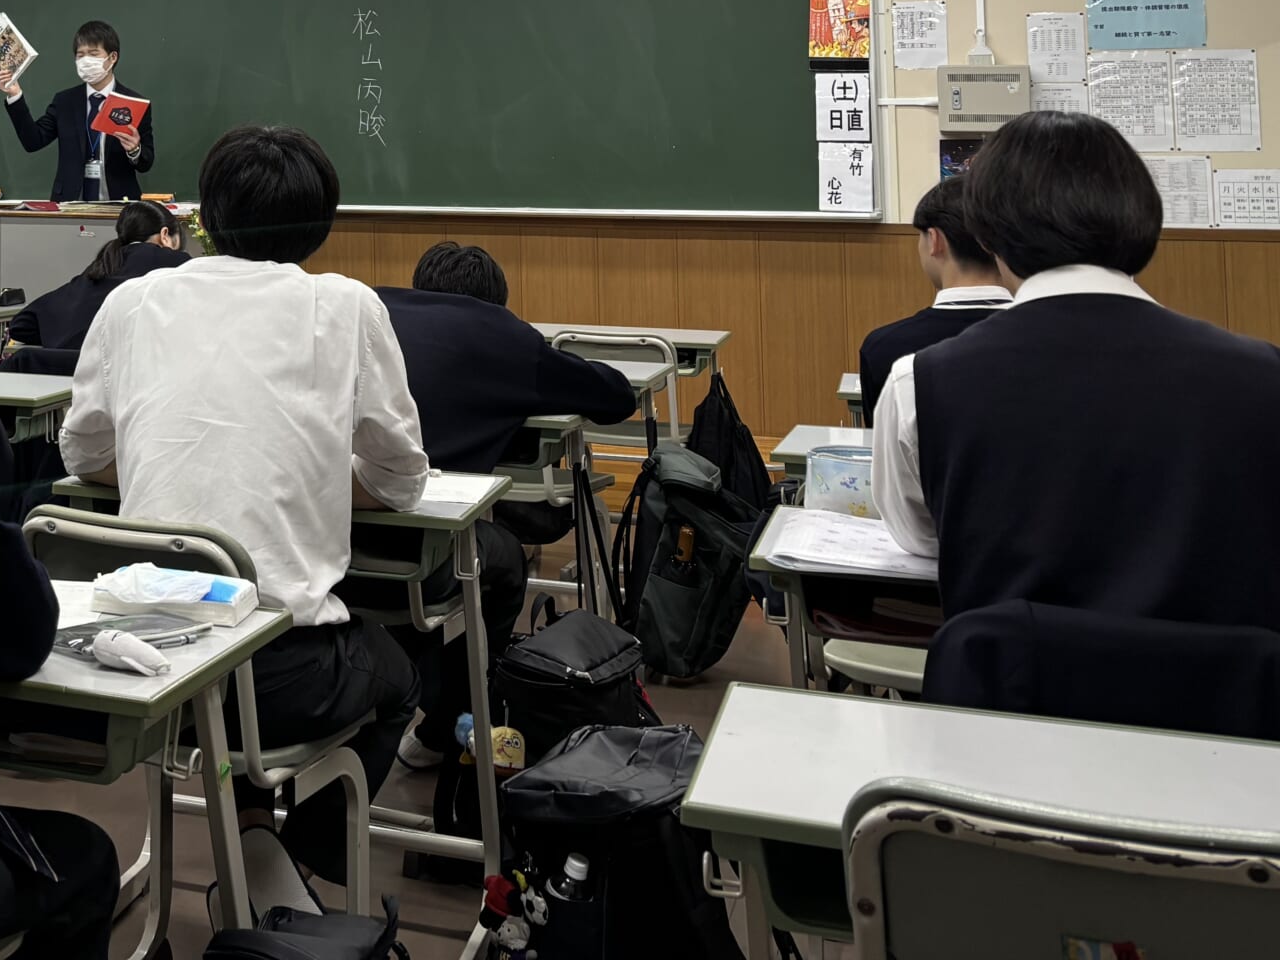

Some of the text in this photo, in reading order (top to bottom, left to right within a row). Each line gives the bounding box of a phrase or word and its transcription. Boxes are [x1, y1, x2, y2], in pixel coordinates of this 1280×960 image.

[829, 108, 864, 132] 日直
[849, 147, 864, 177] 有竹
[1223, 185, 1230, 193] 月
